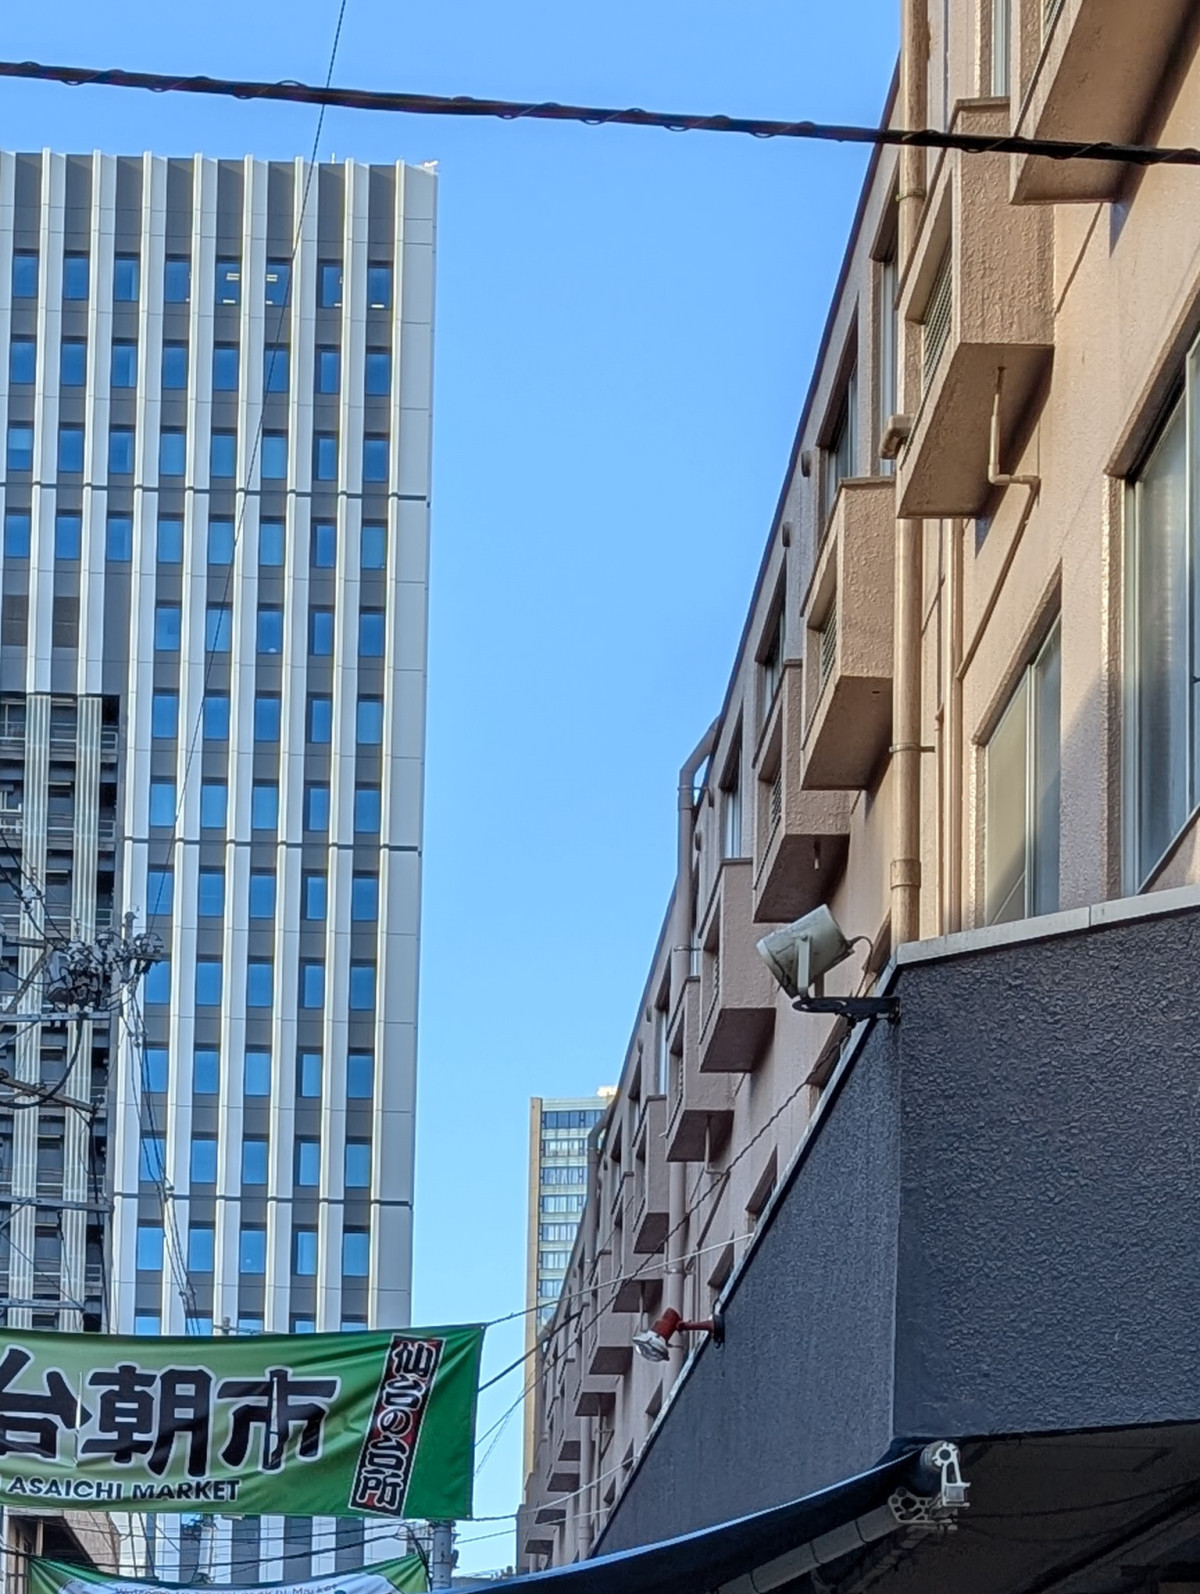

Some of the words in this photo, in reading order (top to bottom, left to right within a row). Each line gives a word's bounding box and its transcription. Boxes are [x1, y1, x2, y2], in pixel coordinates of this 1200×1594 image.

[355, 1341, 436, 1511] 仙台の台所
[8, 1475, 123, 1501] ASAICHI
[131, 1480, 240, 1501] MARKET
